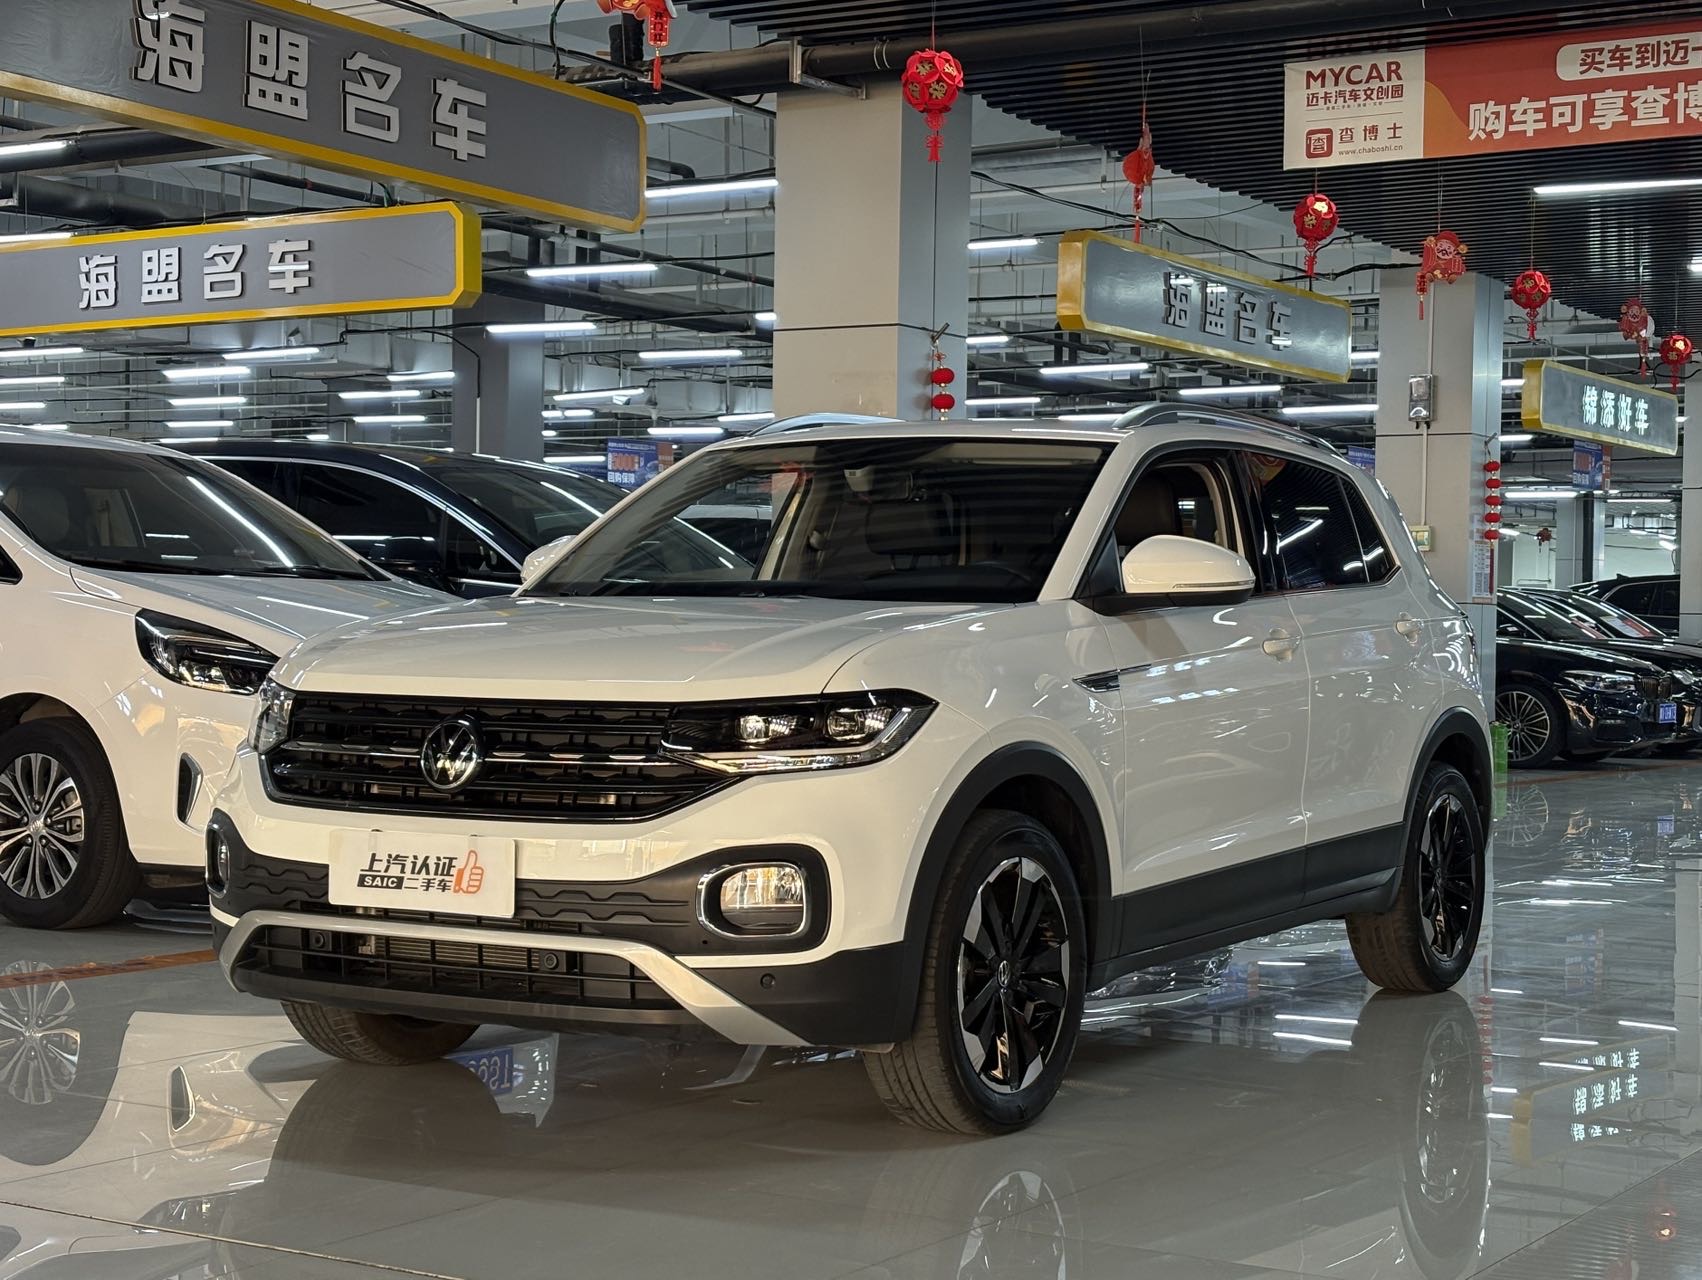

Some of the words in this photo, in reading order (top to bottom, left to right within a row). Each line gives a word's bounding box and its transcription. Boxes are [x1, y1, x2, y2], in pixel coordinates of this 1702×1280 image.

[1579, 38, 1702, 75] 买车到迈
[131, 0, 487, 161] 海盟名车
[1305, 61, 1402, 90] MYCAR
[1305, 84, 1404, 107] 迈卡汽车文创园
[1338, 122, 1403, 144] 查博士
[1338, 144, 1403, 156] www.chaboshi.cn
[78, 239, 312, 309] 海盟名车
[360, 852, 458, 877] 上汽认证
[363, 876, 398, 888] SAIC
[404, 877, 454, 893] 二手车
